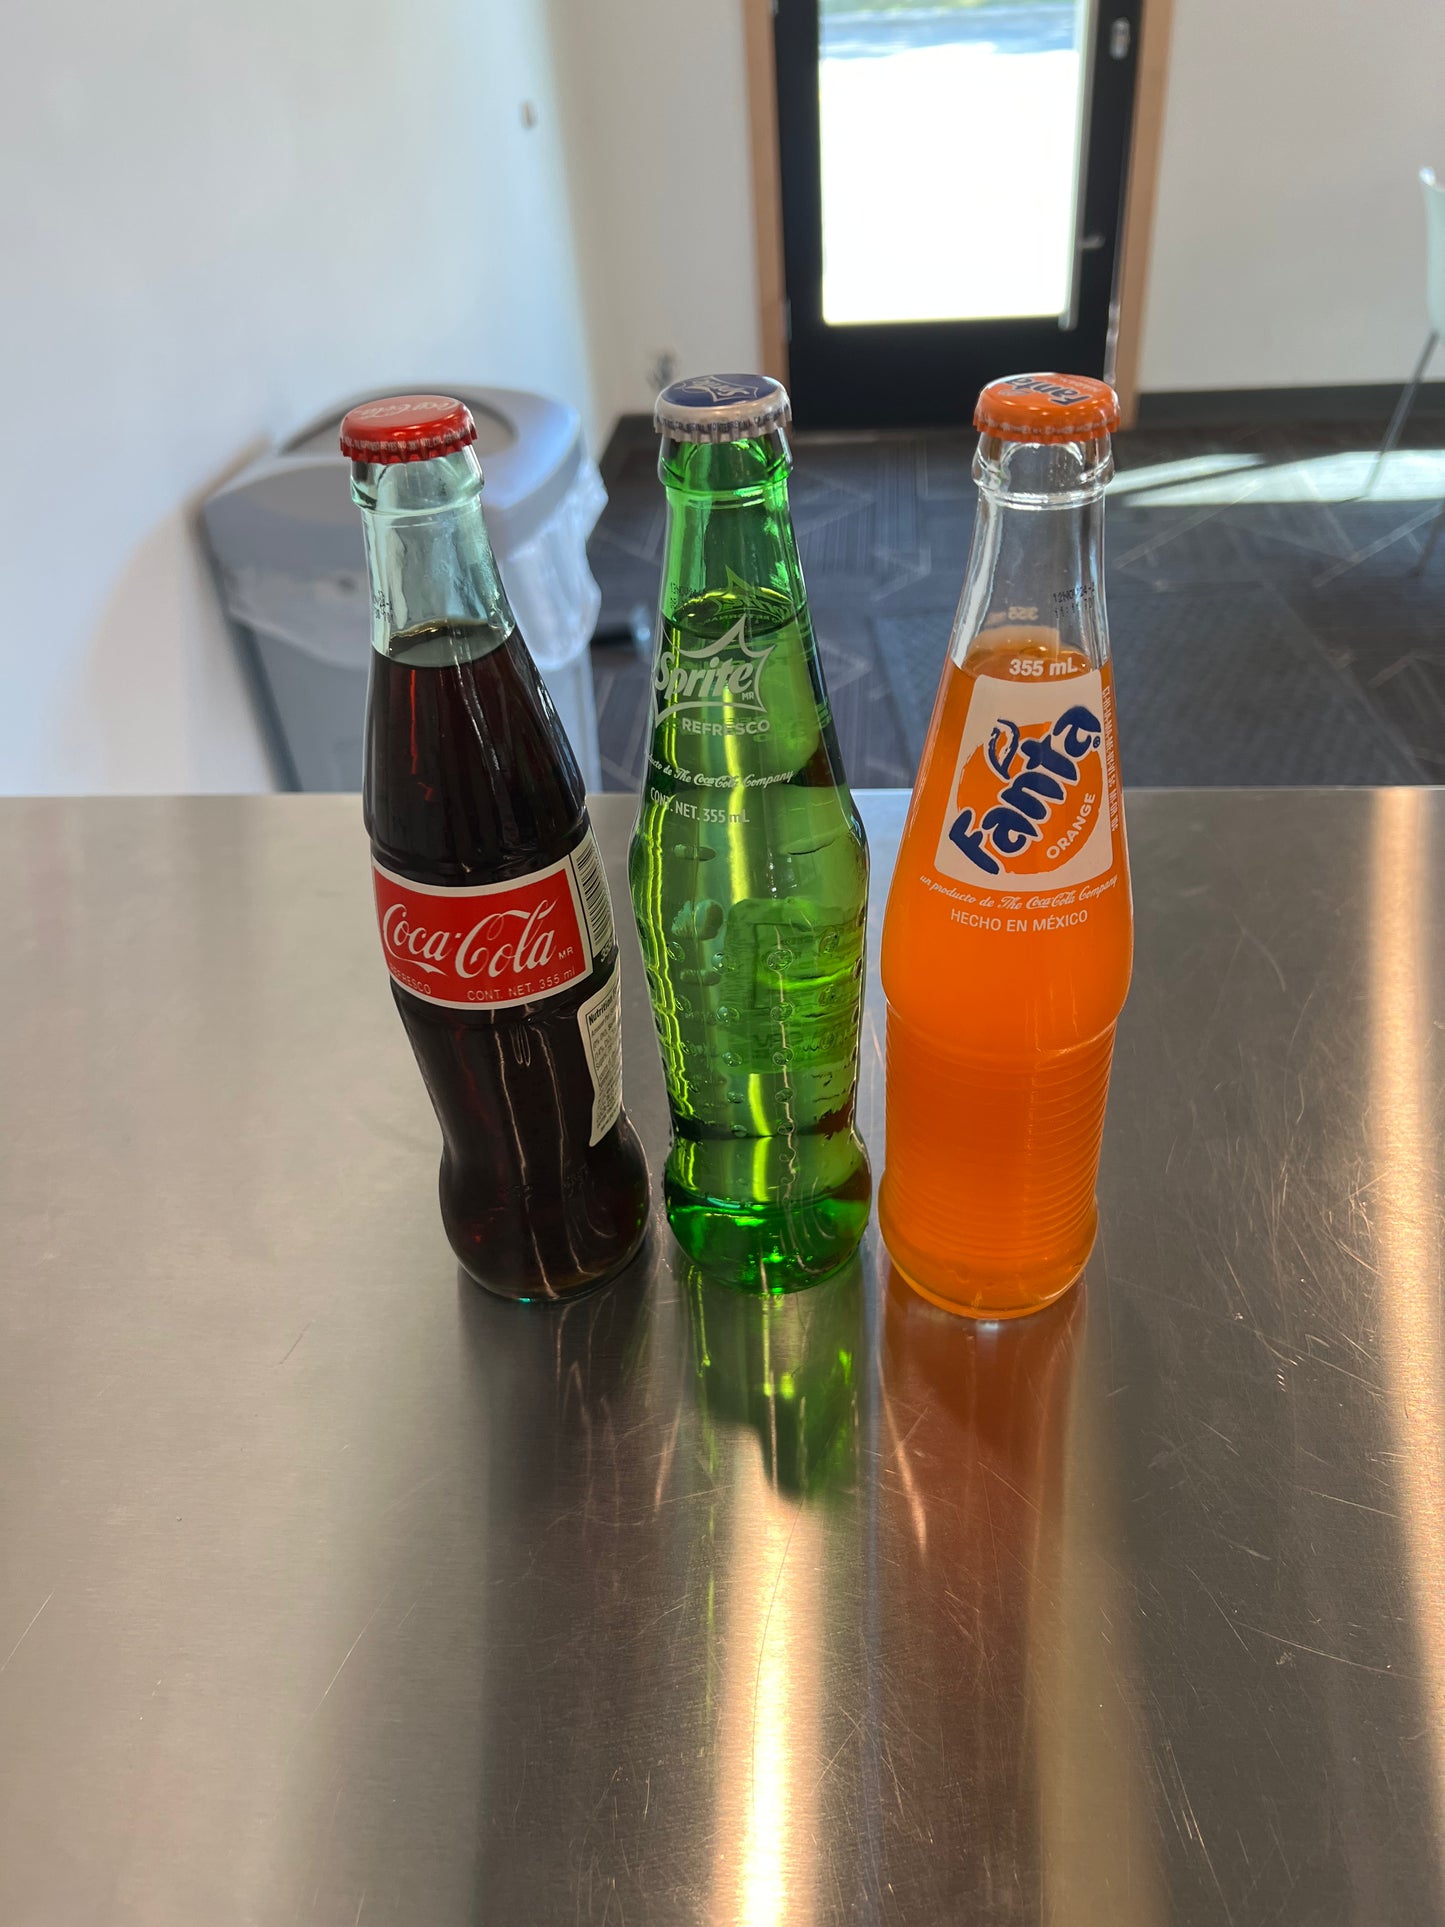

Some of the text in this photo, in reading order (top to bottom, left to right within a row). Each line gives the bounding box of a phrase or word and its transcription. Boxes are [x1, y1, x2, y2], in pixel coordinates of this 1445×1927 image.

[1002, 377, 1092, 406] Fanta
[655, 651, 754, 700] Sprite
[1009, 657, 1078, 676] 355 mL
[741, 691, 755, 701] MR
[681, 717, 771, 736] REFRESCO
[662, 765, 673, 776] de
[673, 767, 692, 783] The
[743, 770, 794, 789] Company
[948, 705, 1102, 876] Fanta
[675, 800, 701, 821] NET.
[703, 808, 726, 823] 355
[729, 808, 750, 823] mL
[1046, 792, 1096, 860] ORANGE
[919, 875, 932, 886] un
[931, 883, 977, 904] producto
[979, 896, 995, 908] de
[997, 895, 1023, 910] The
[1078, 874, 1118, 901] Company
[950, 908, 1088, 933] HECHO EN MÉXICO
[558, 946, 575, 961] MR
[466, 988, 504, 1002] CONT.
[508, 982, 535, 998] NET.
[539, 974, 561, 990] 355
